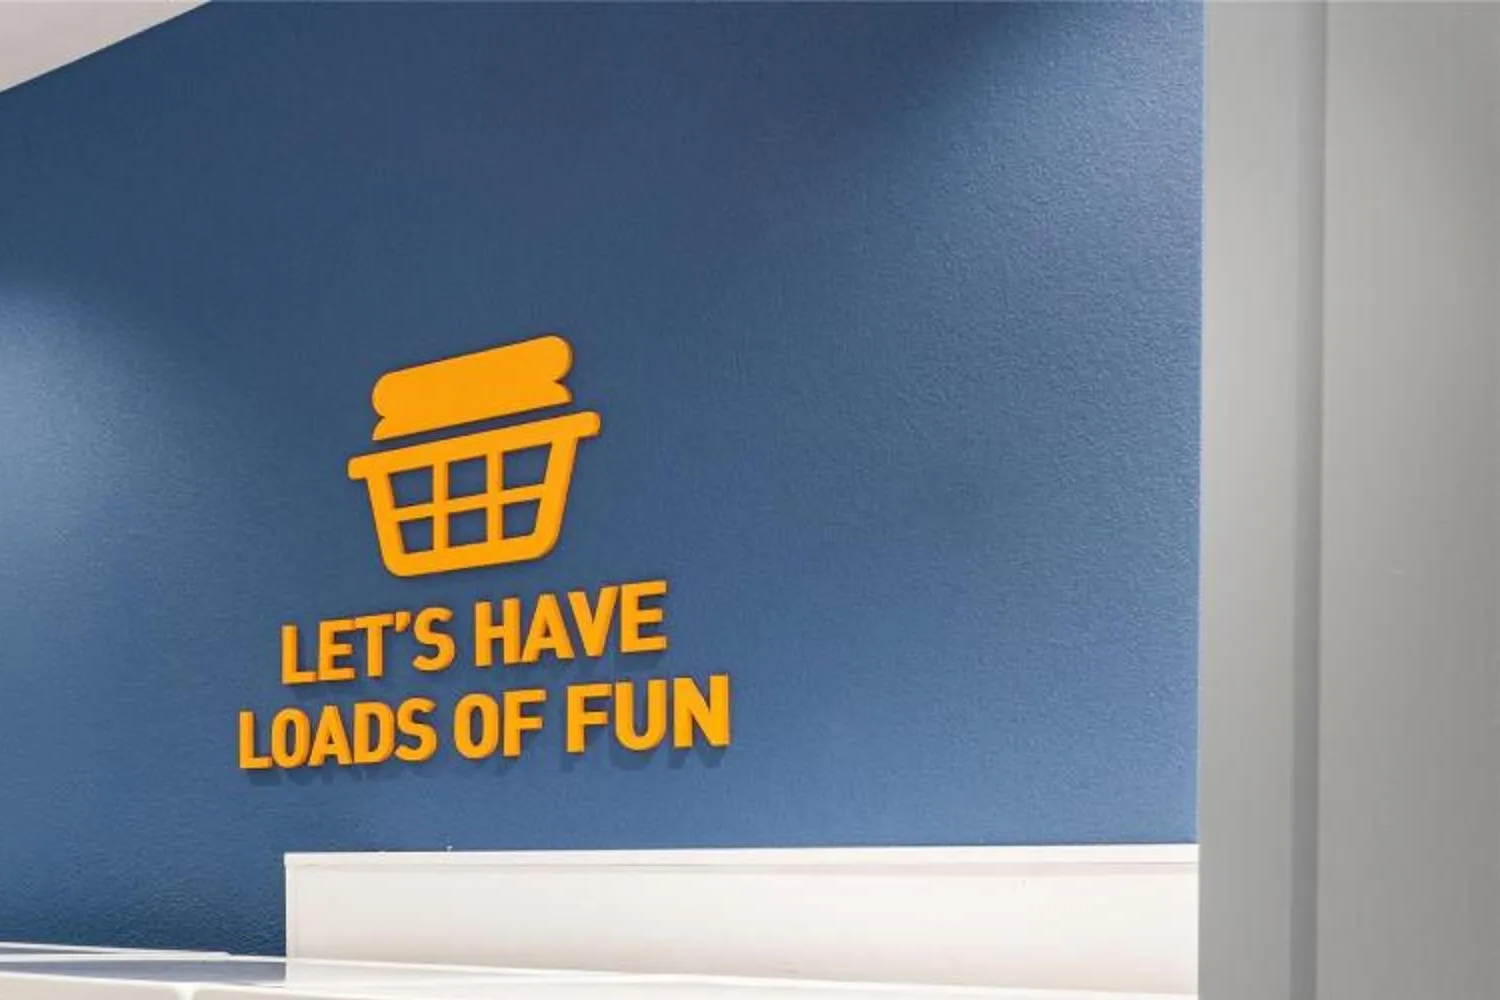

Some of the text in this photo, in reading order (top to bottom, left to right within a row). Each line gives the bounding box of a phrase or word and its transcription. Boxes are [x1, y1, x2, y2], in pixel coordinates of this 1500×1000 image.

[281, 580, 668, 684] LET'S HAVE
[238, 673, 730, 770] LOADS OF FUN
